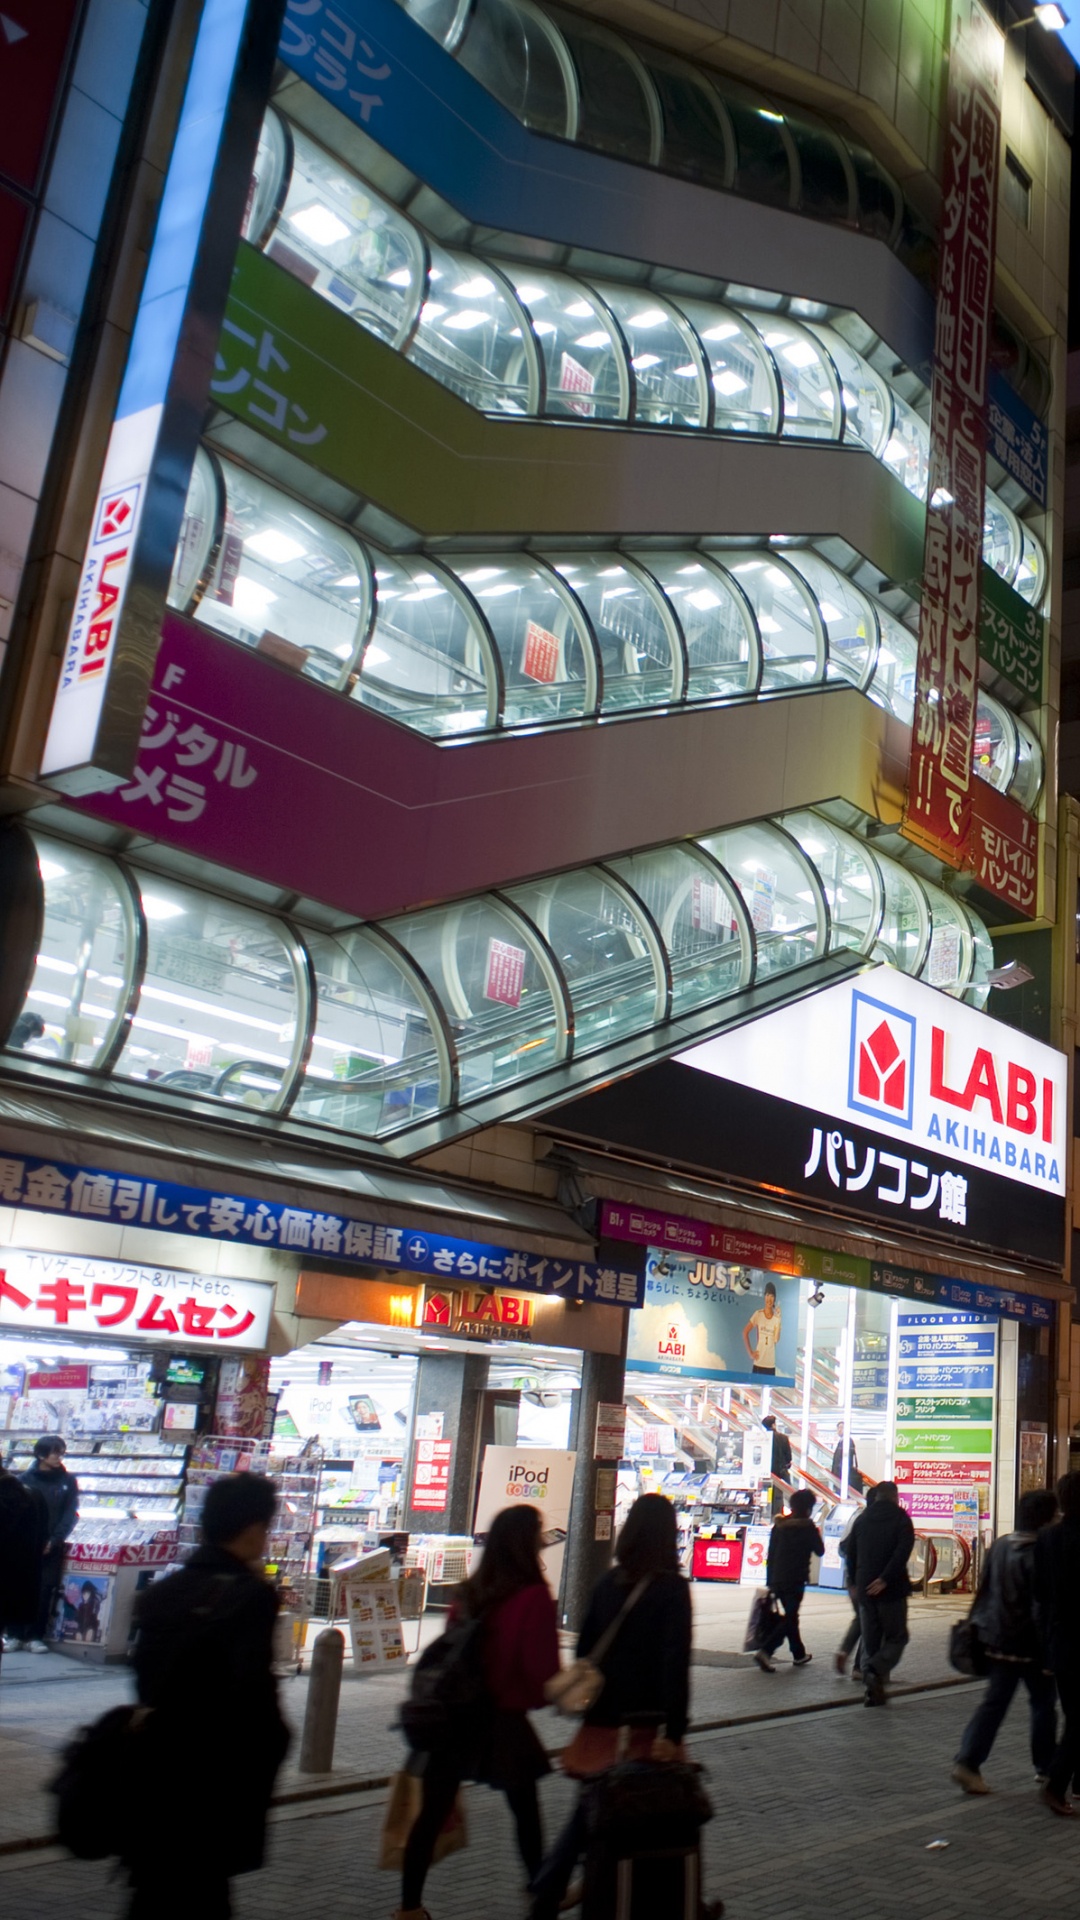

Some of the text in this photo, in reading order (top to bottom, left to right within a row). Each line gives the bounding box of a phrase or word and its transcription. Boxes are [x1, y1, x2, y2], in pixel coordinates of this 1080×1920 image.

[62, 558, 97, 690] AKIHABARA
[78, 547, 129, 677] LABI
[992, 640, 1039, 692] パソコン
[104, 765, 207, 822] メラ
[980, 825, 1035, 880] モバイル
[1022, 818, 1036, 850] 1F
[980, 857, 1035, 906] パソコン
[930, 1025, 1054, 1144] LABI
[926, 1112, 1060, 1184] AKIHABARA
[804, 1127, 968, 1226] パソコン館
[433, 1247, 638, 1304] さらにポイント進呈
[460, 1291, 531, 1326] LABI
[952, 1315, 988, 1323] GUIDE
[658, 1341, 685, 1356] LABI
[506, 1483, 547, 1498] touch
[508, 1465, 549, 1484] iPod
[911, 1502, 953, 1511] デジタルビデオ
[122, 1544, 178, 1564] SALE
[157, 1531, 179, 1541] SAL
